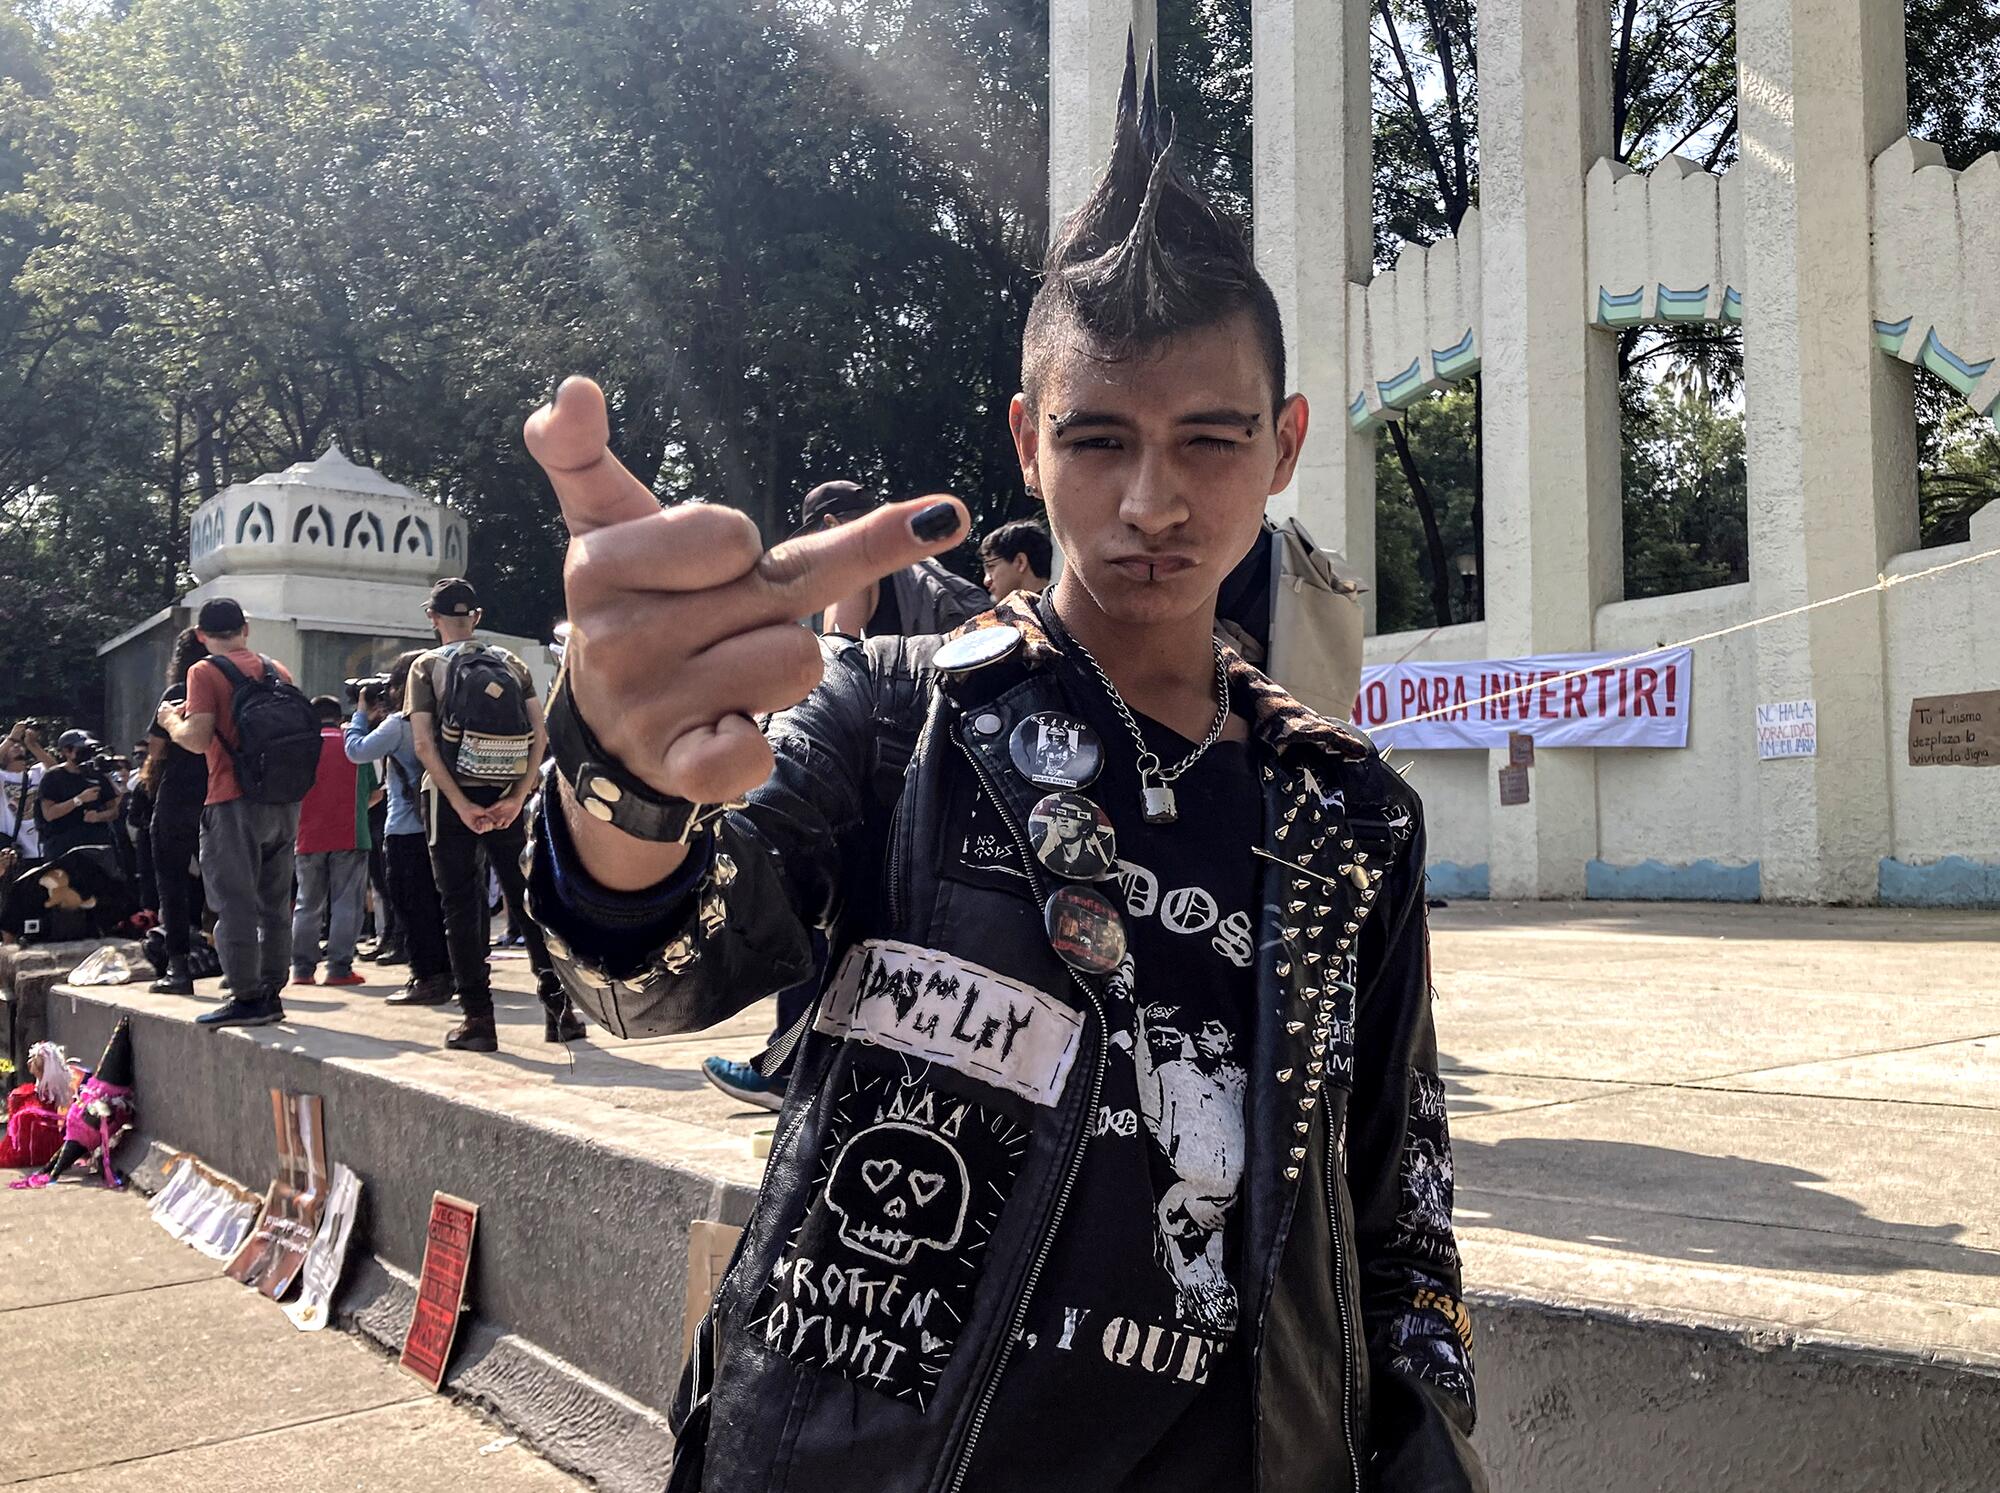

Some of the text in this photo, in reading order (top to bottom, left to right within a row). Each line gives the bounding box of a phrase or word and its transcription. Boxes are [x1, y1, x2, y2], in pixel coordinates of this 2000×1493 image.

[1401, 676, 1468, 722] PARA
[1480, 665, 1677, 722] INVERTIR!
[977, 835, 996, 846] NO
[912, 981, 1035, 1063] LA LEY
[793, 1257, 940, 1329] ROTTEN
